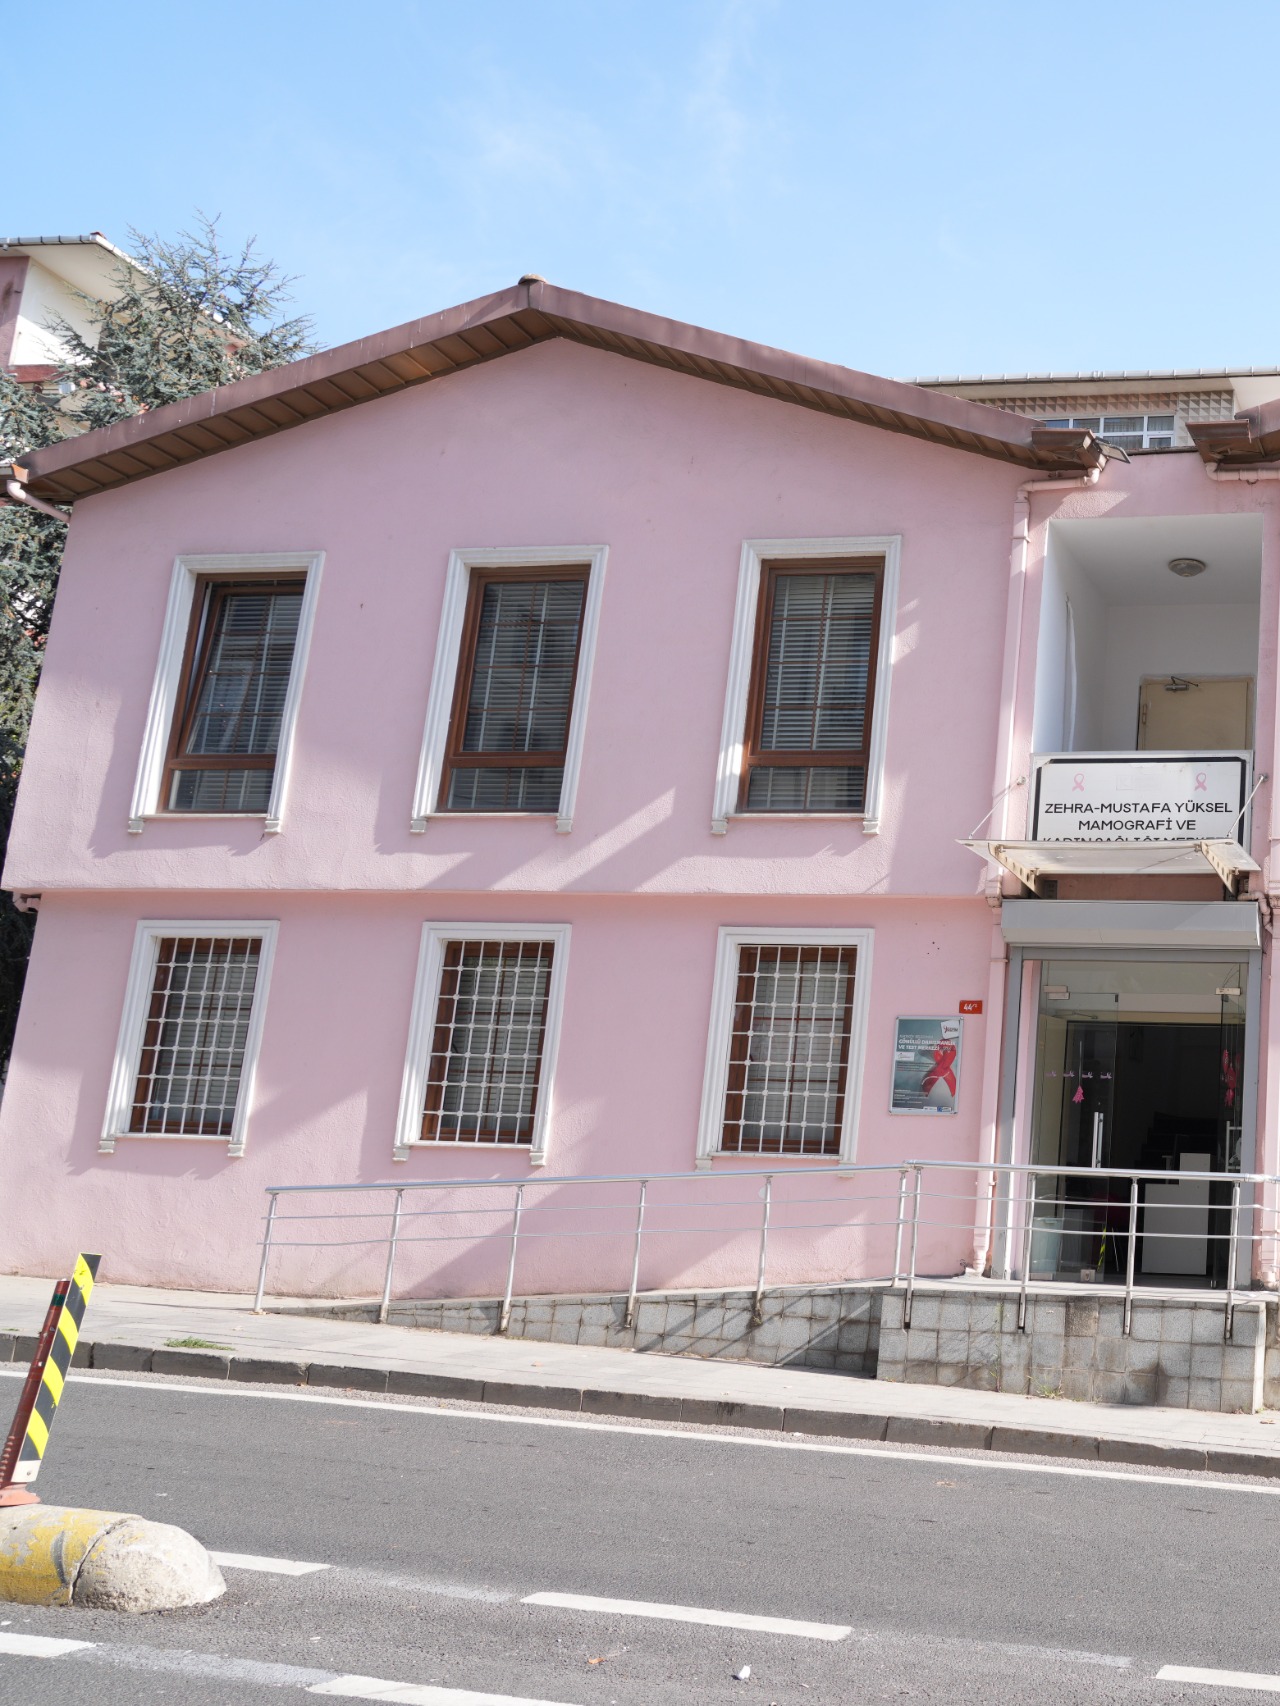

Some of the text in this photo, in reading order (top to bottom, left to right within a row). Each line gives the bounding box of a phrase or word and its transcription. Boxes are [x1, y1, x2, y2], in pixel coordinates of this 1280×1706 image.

[1044, 800, 1233, 814] ZEHRA-MUSTAFA YÜKSEL
[1078, 818, 1197, 831] MAMOGRAFİ VE
